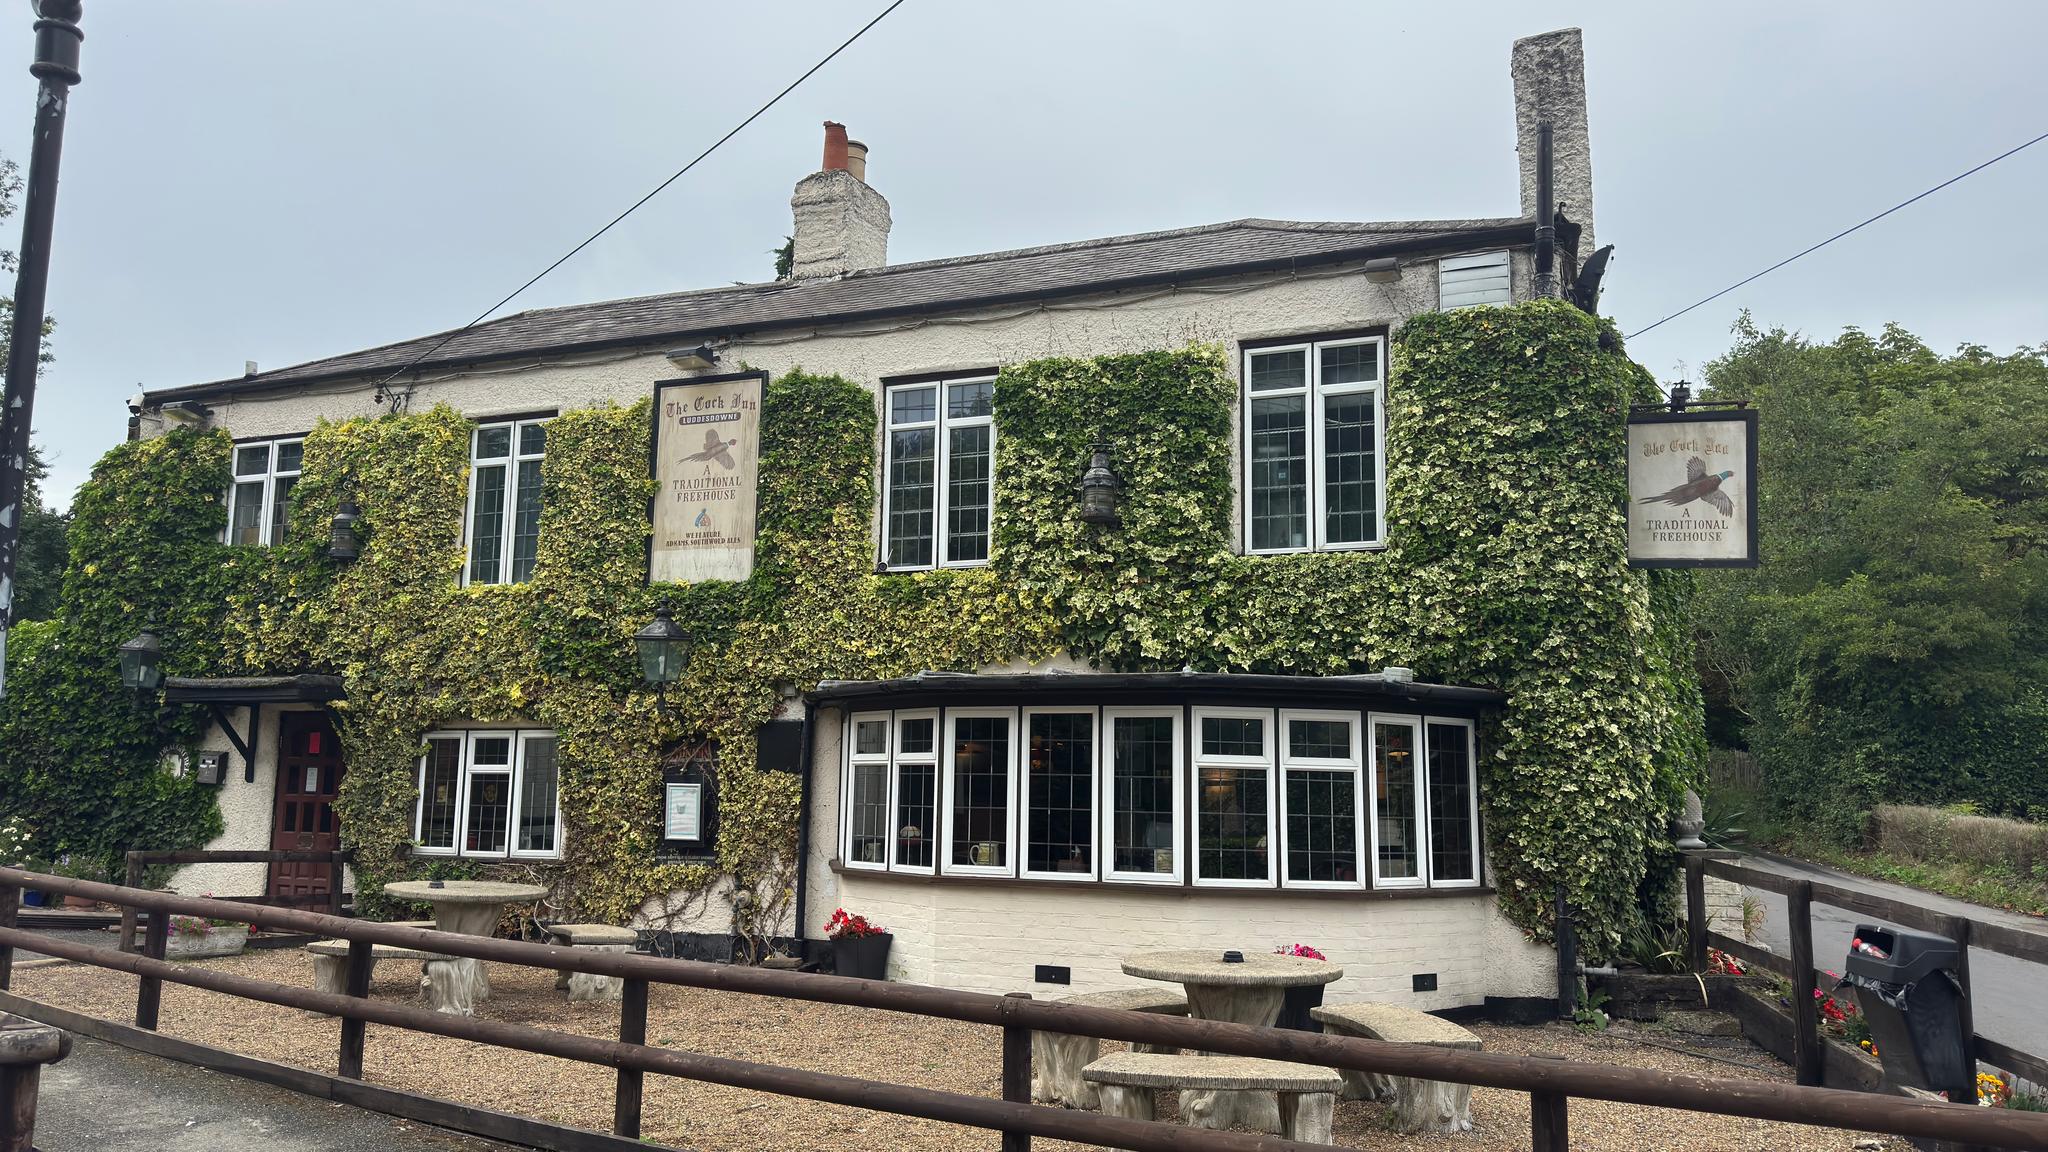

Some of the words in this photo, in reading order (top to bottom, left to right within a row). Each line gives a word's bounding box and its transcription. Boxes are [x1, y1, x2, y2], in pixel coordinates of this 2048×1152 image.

[666, 401, 688, 418] The
[694, 394, 724, 411] Cock
[731, 392, 756, 410] Inn
[682, 413, 738, 424] LUDDESDOWNE
[1643, 443, 1665, 457] The
[1670, 439, 1699, 453] Cock
[1704, 438, 1729, 455] Inn
[703, 465, 710, 475] A
[673, 476, 742, 490] TRADITIONAL
[677, 490, 735, 502] FREEHOUSE
[1682, 508, 1690, 517] A
[1647, 520, 1728, 530] TRADITIONAL
[690, 538, 725, 546] SOUTHWOLD
[1652, 532, 1722, 542] FREEHOUSE
